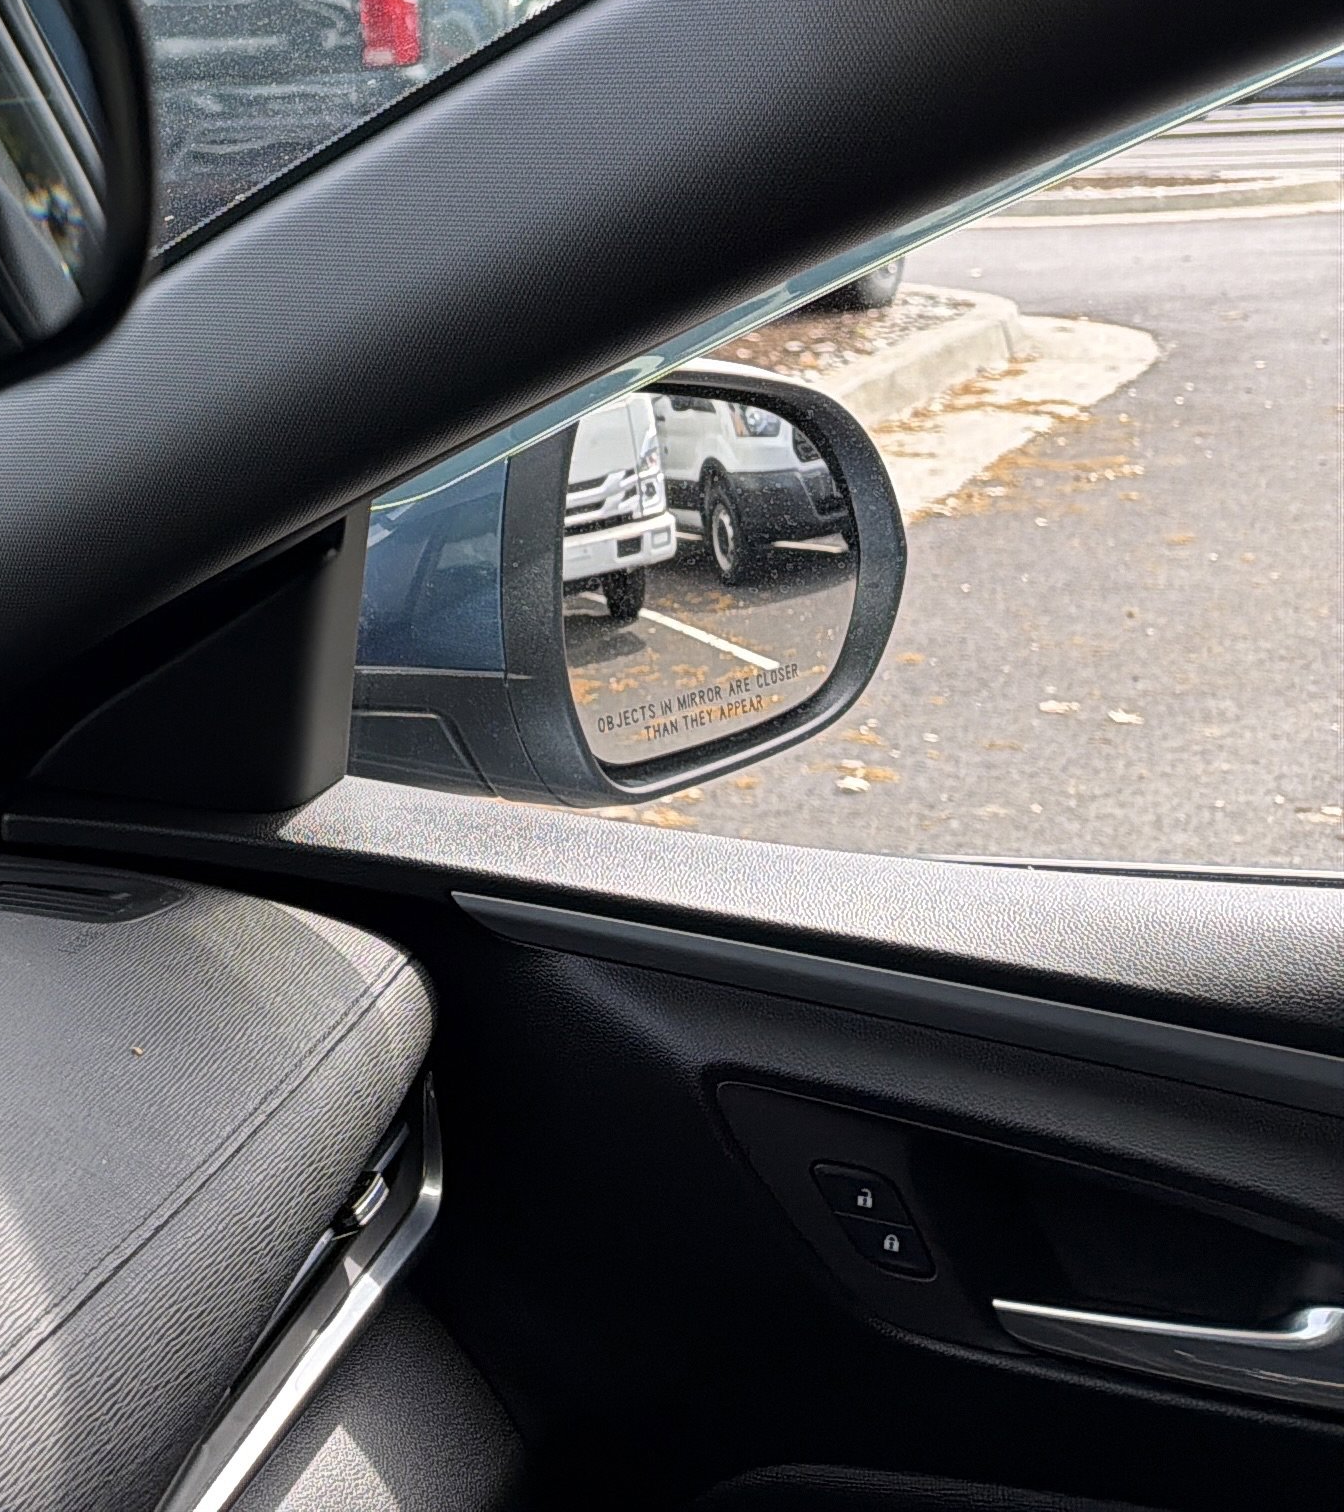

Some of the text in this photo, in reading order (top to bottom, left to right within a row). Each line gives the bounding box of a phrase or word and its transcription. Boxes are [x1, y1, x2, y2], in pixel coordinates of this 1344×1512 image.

[597, 663, 799, 733] OBJECTS IN MIRROR ARE CLOSER
[643, 694, 764, 742] THAN THEY APPEAR
